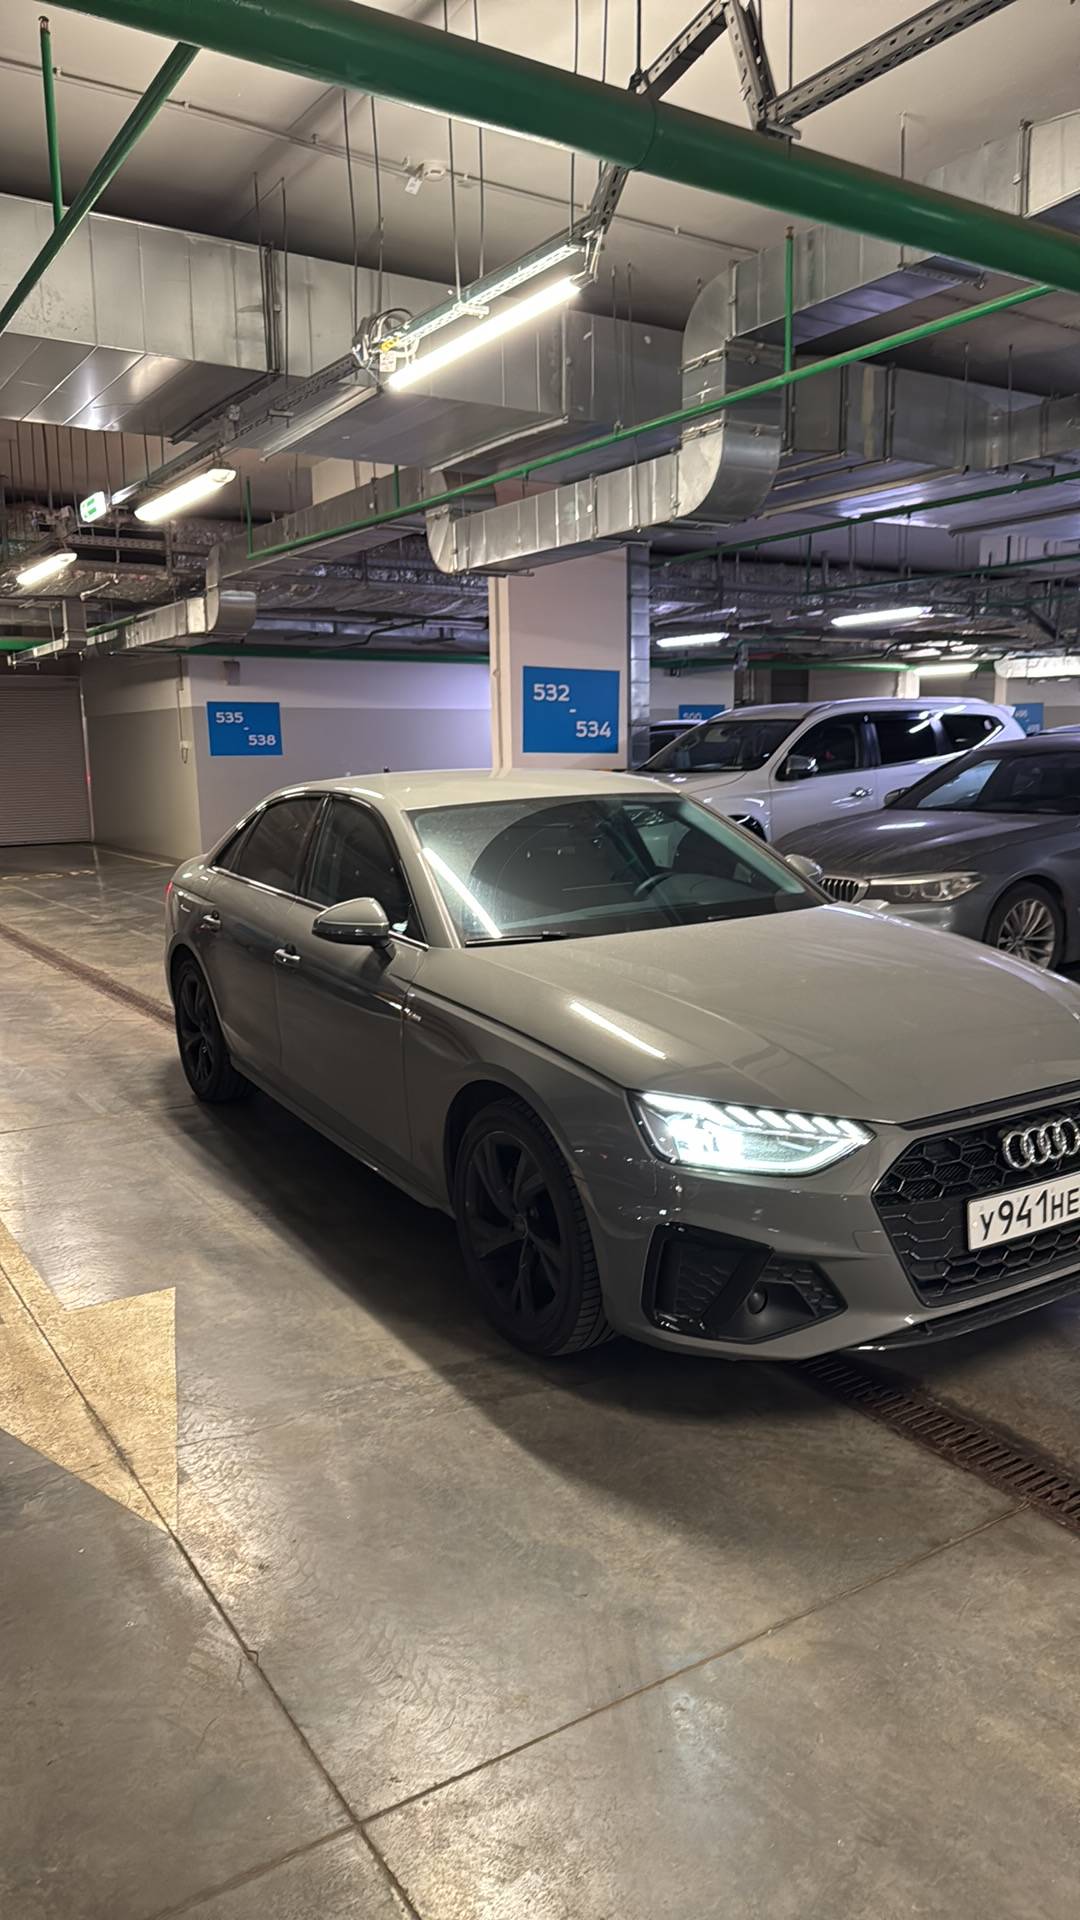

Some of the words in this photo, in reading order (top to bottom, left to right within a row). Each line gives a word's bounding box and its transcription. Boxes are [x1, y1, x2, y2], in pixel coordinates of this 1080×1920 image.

[533, 683, 570, 702] 532
[215, 711, 244, 723] 535
[575, 721, 612, 738] 534
[248, 734, 277, 746] 538
[979, 1187, 1080, 1241] У941НЕ
